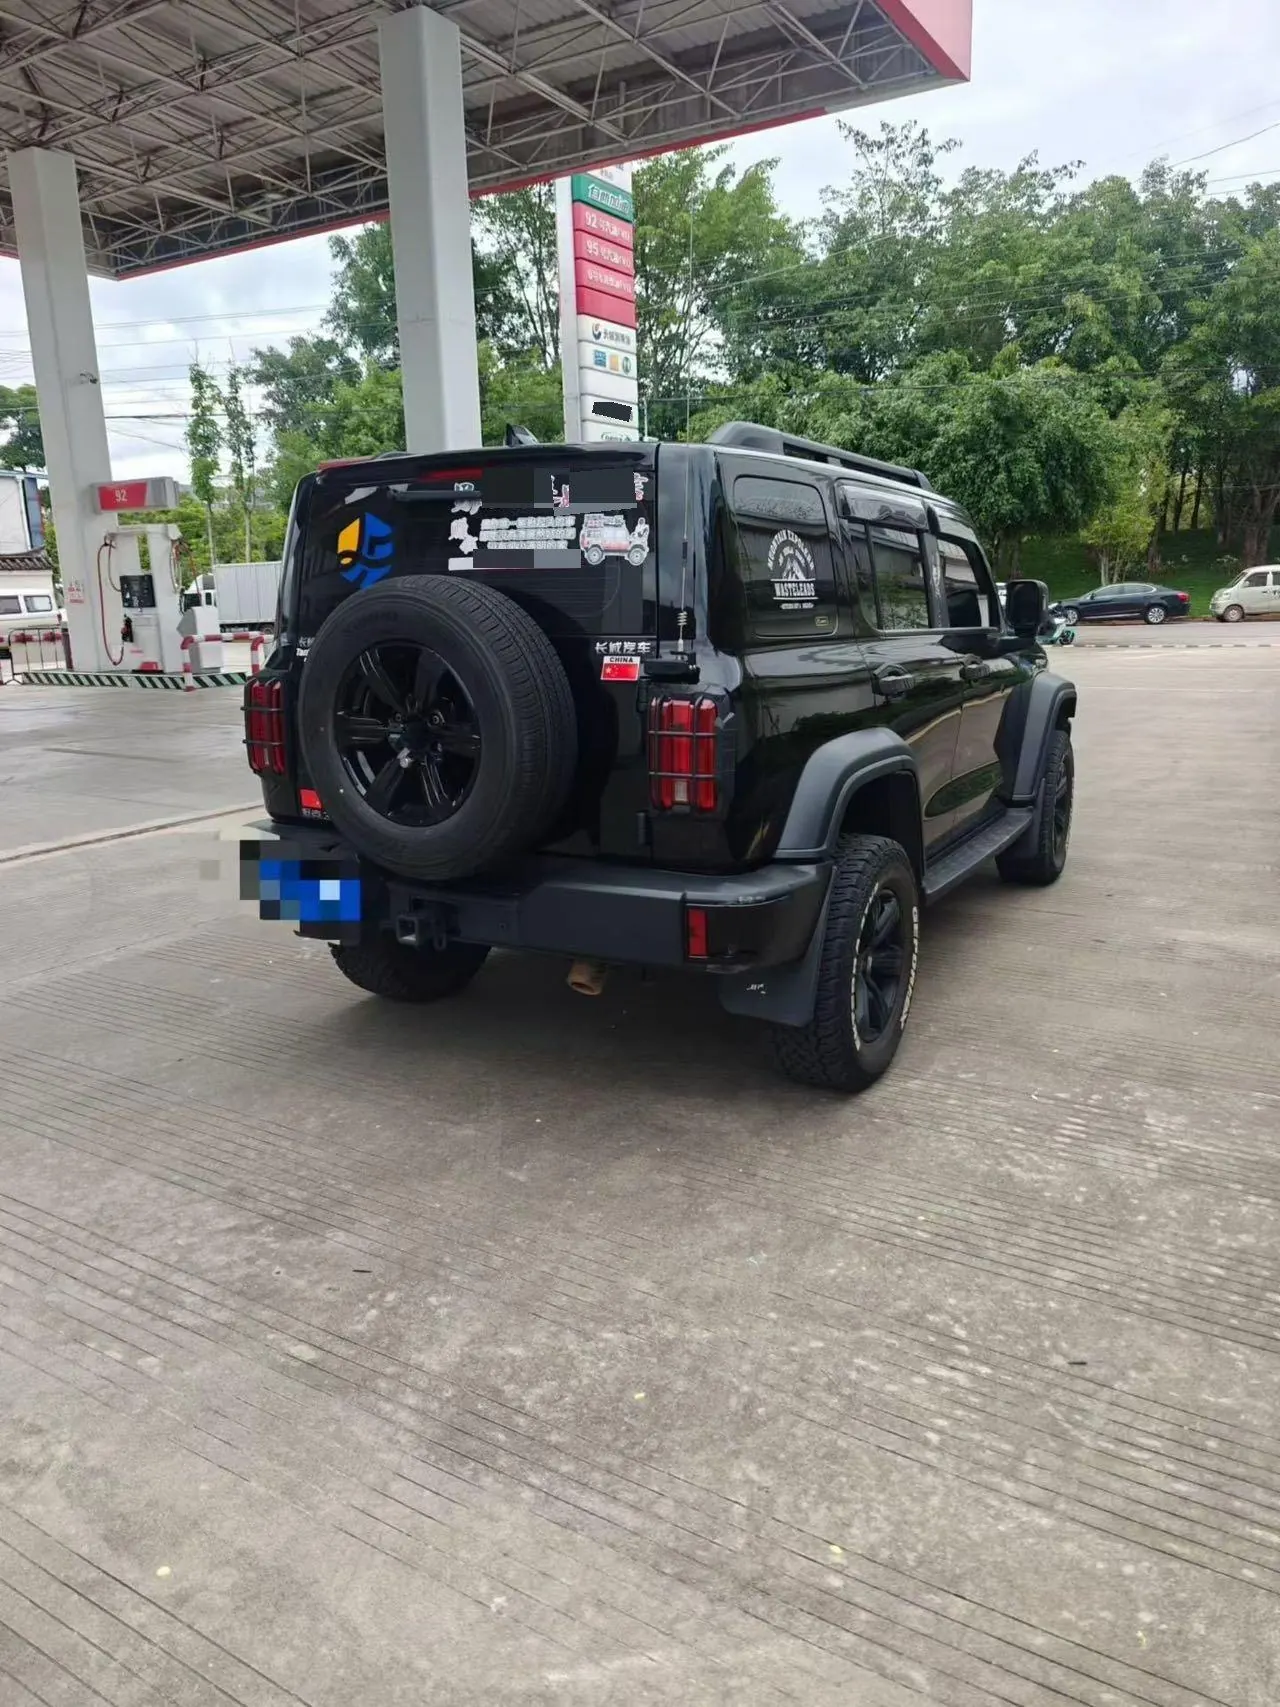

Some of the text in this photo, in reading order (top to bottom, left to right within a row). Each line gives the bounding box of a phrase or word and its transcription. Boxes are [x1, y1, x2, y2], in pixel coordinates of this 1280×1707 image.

[115, 489, 128, 502] 92
[595, 641, 651, 654] 长城汽车
